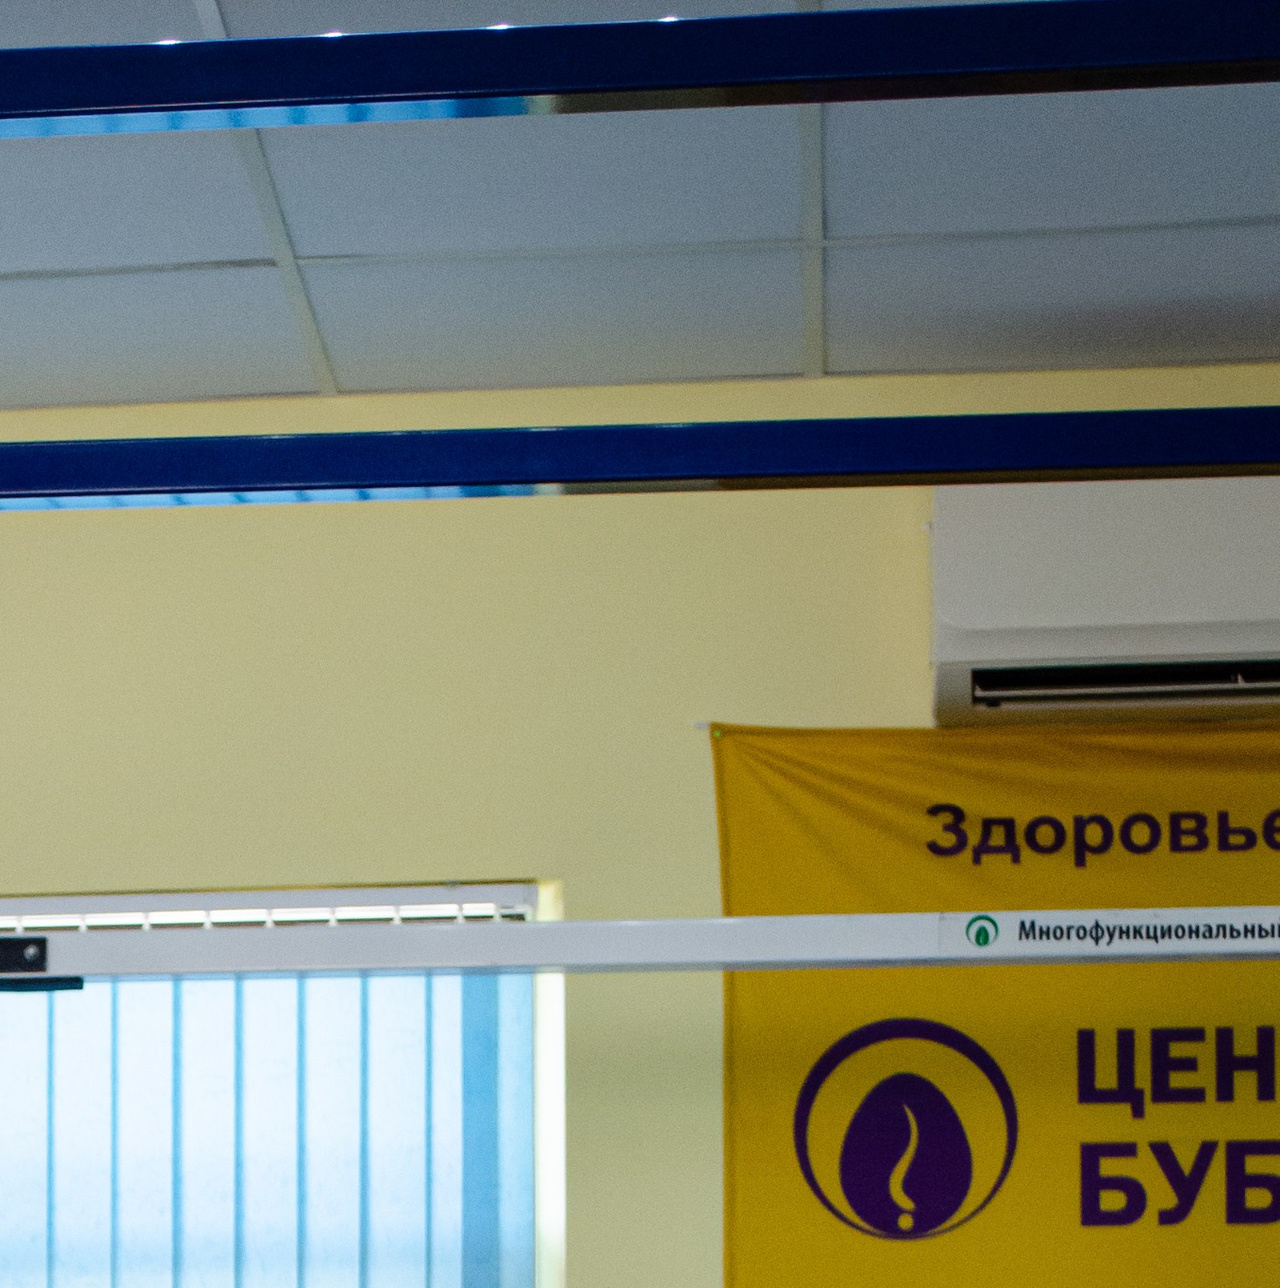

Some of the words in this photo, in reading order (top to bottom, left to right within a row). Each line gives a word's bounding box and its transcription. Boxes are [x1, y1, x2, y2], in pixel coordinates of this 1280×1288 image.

[1018, 918, 1280, 946] Многофункциональны
[1077, 1025, 1276, 1119] ЦЕН
[1080, 1140, 1280, 1227] БУБ
